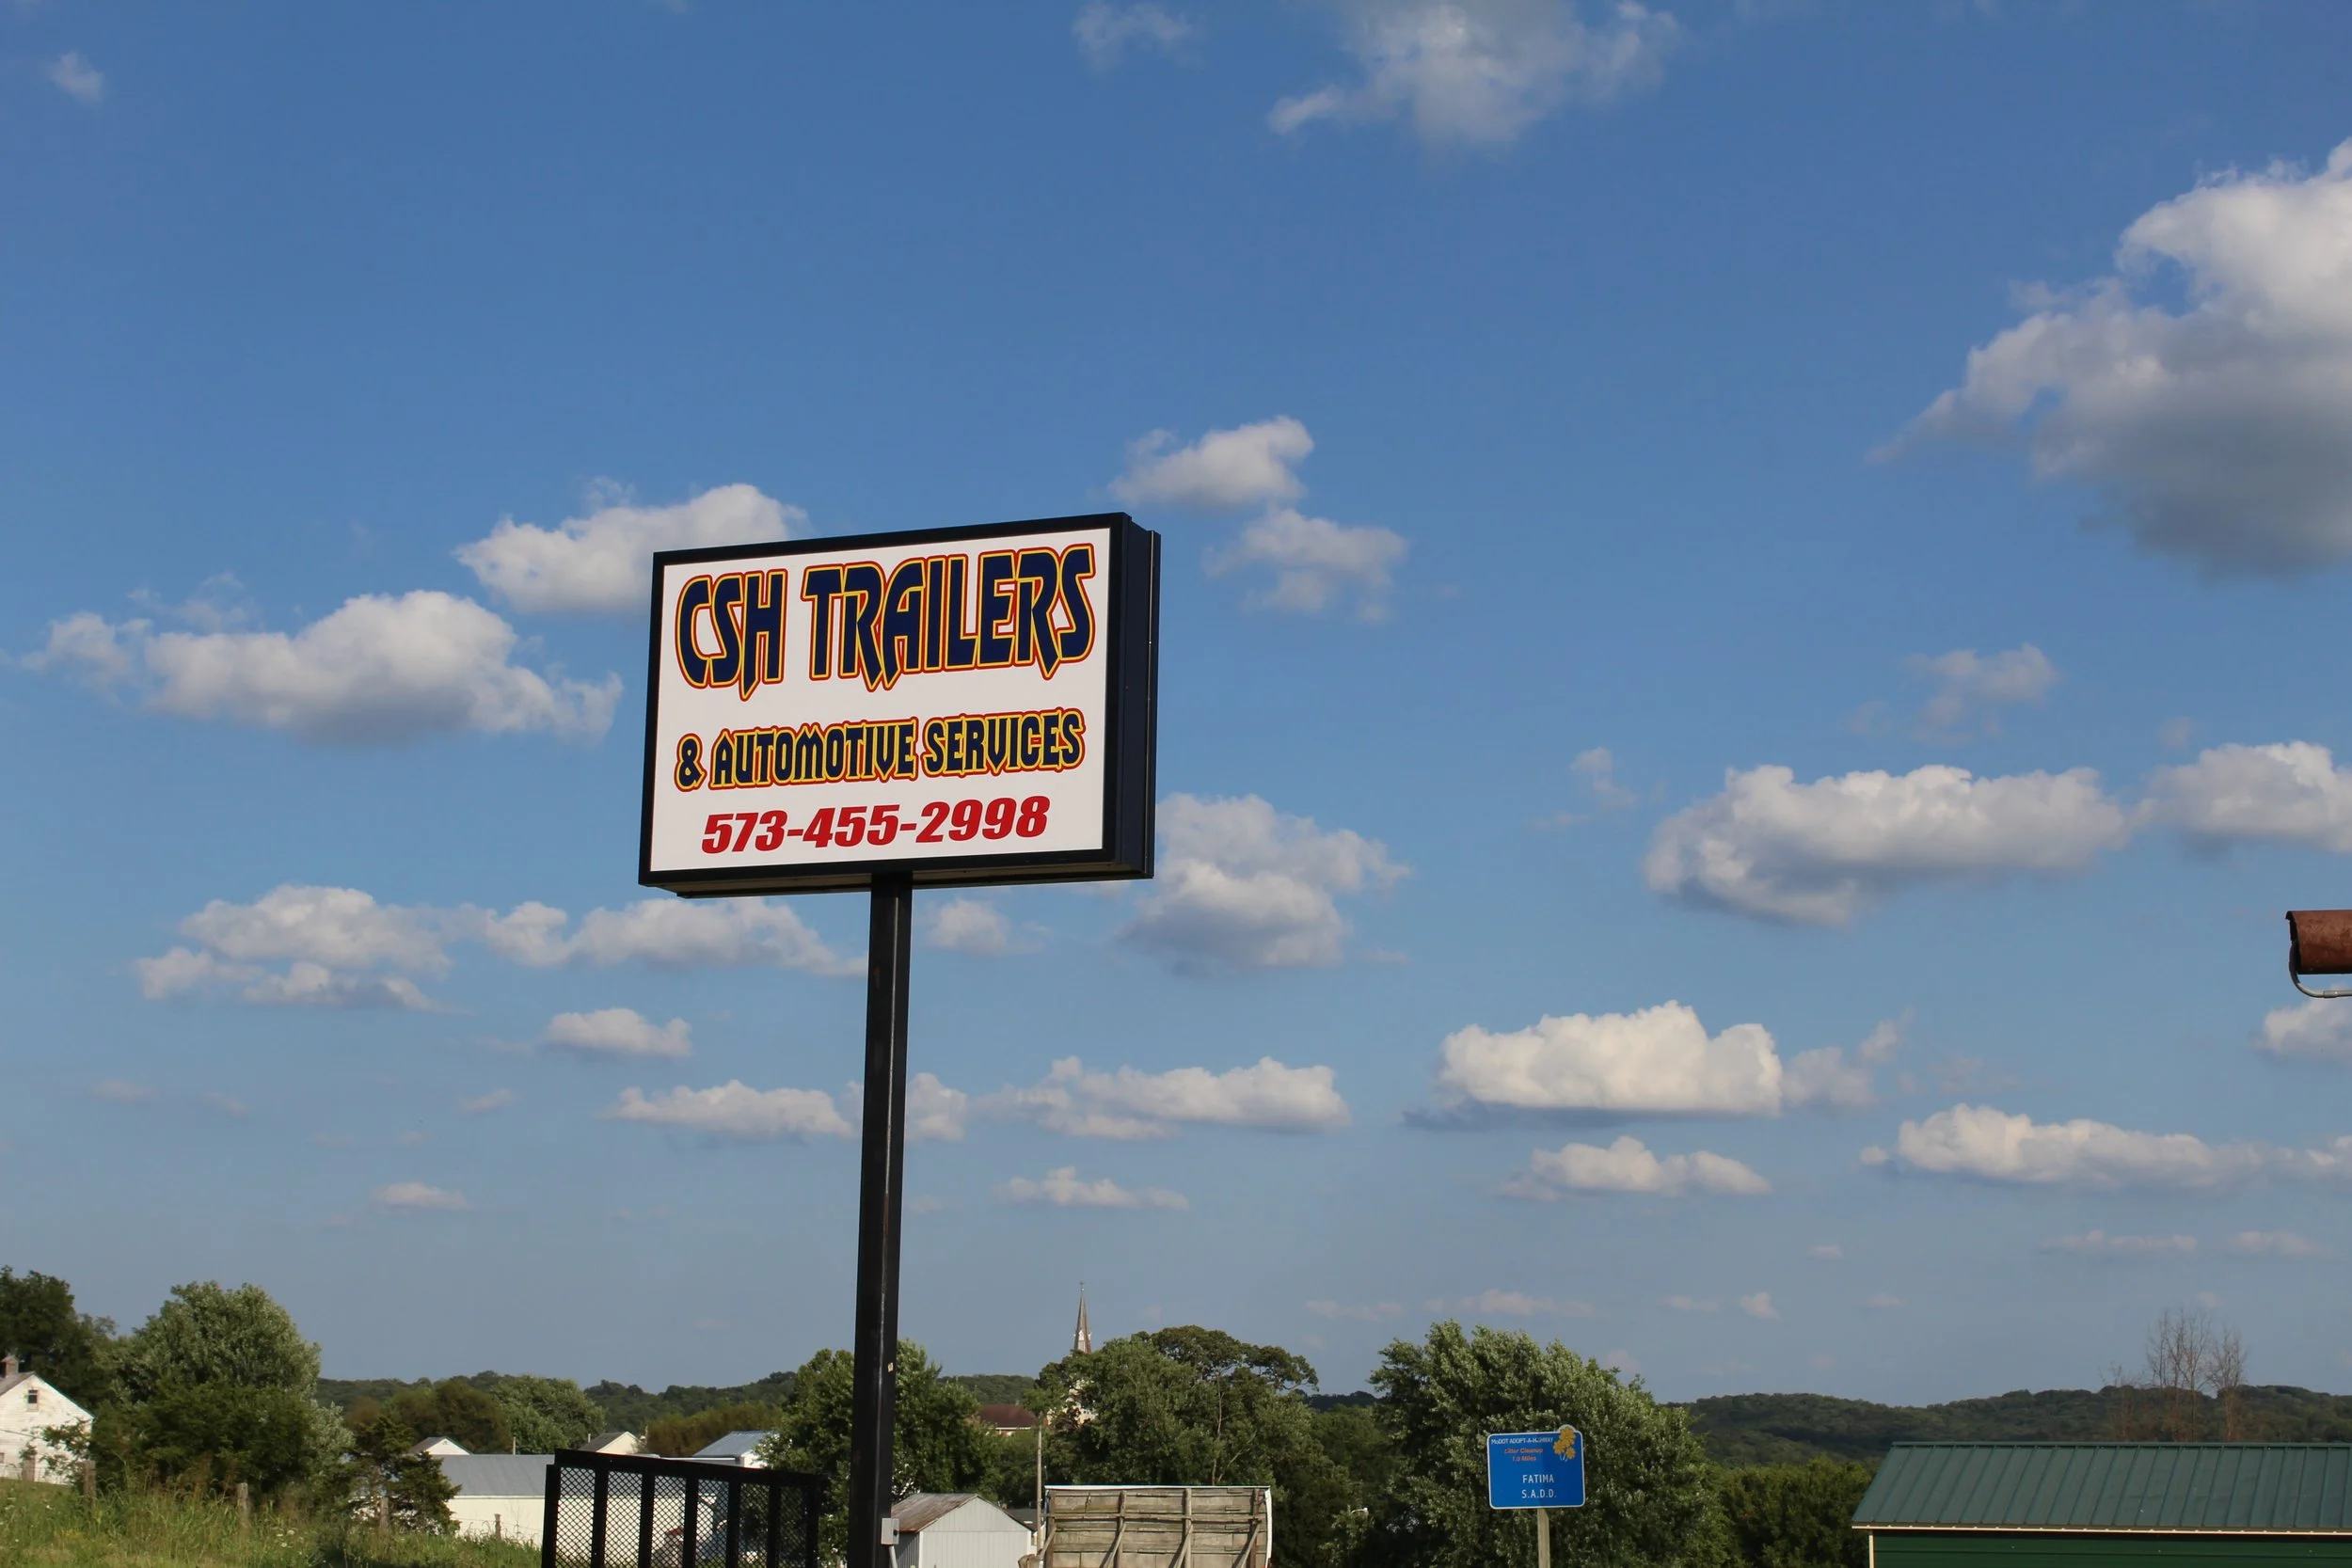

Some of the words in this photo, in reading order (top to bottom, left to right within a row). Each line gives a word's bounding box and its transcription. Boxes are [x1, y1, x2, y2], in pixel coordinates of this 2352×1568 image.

[675, 568, 788, 701] CSH
[801, 543, 1096, 692] TRAILERS
[674, 734, 707, 792] &
[707, 716, 920, 790] AUTOMOTIVE
[921, 707, 1087, 780] SERVICES
[701, 795, 1051, 854] 573-455-2998
[1521, 1489, 1557, 1499] S.A.D.D.
[1522, 1474, 1555, 1483] FATIMA
